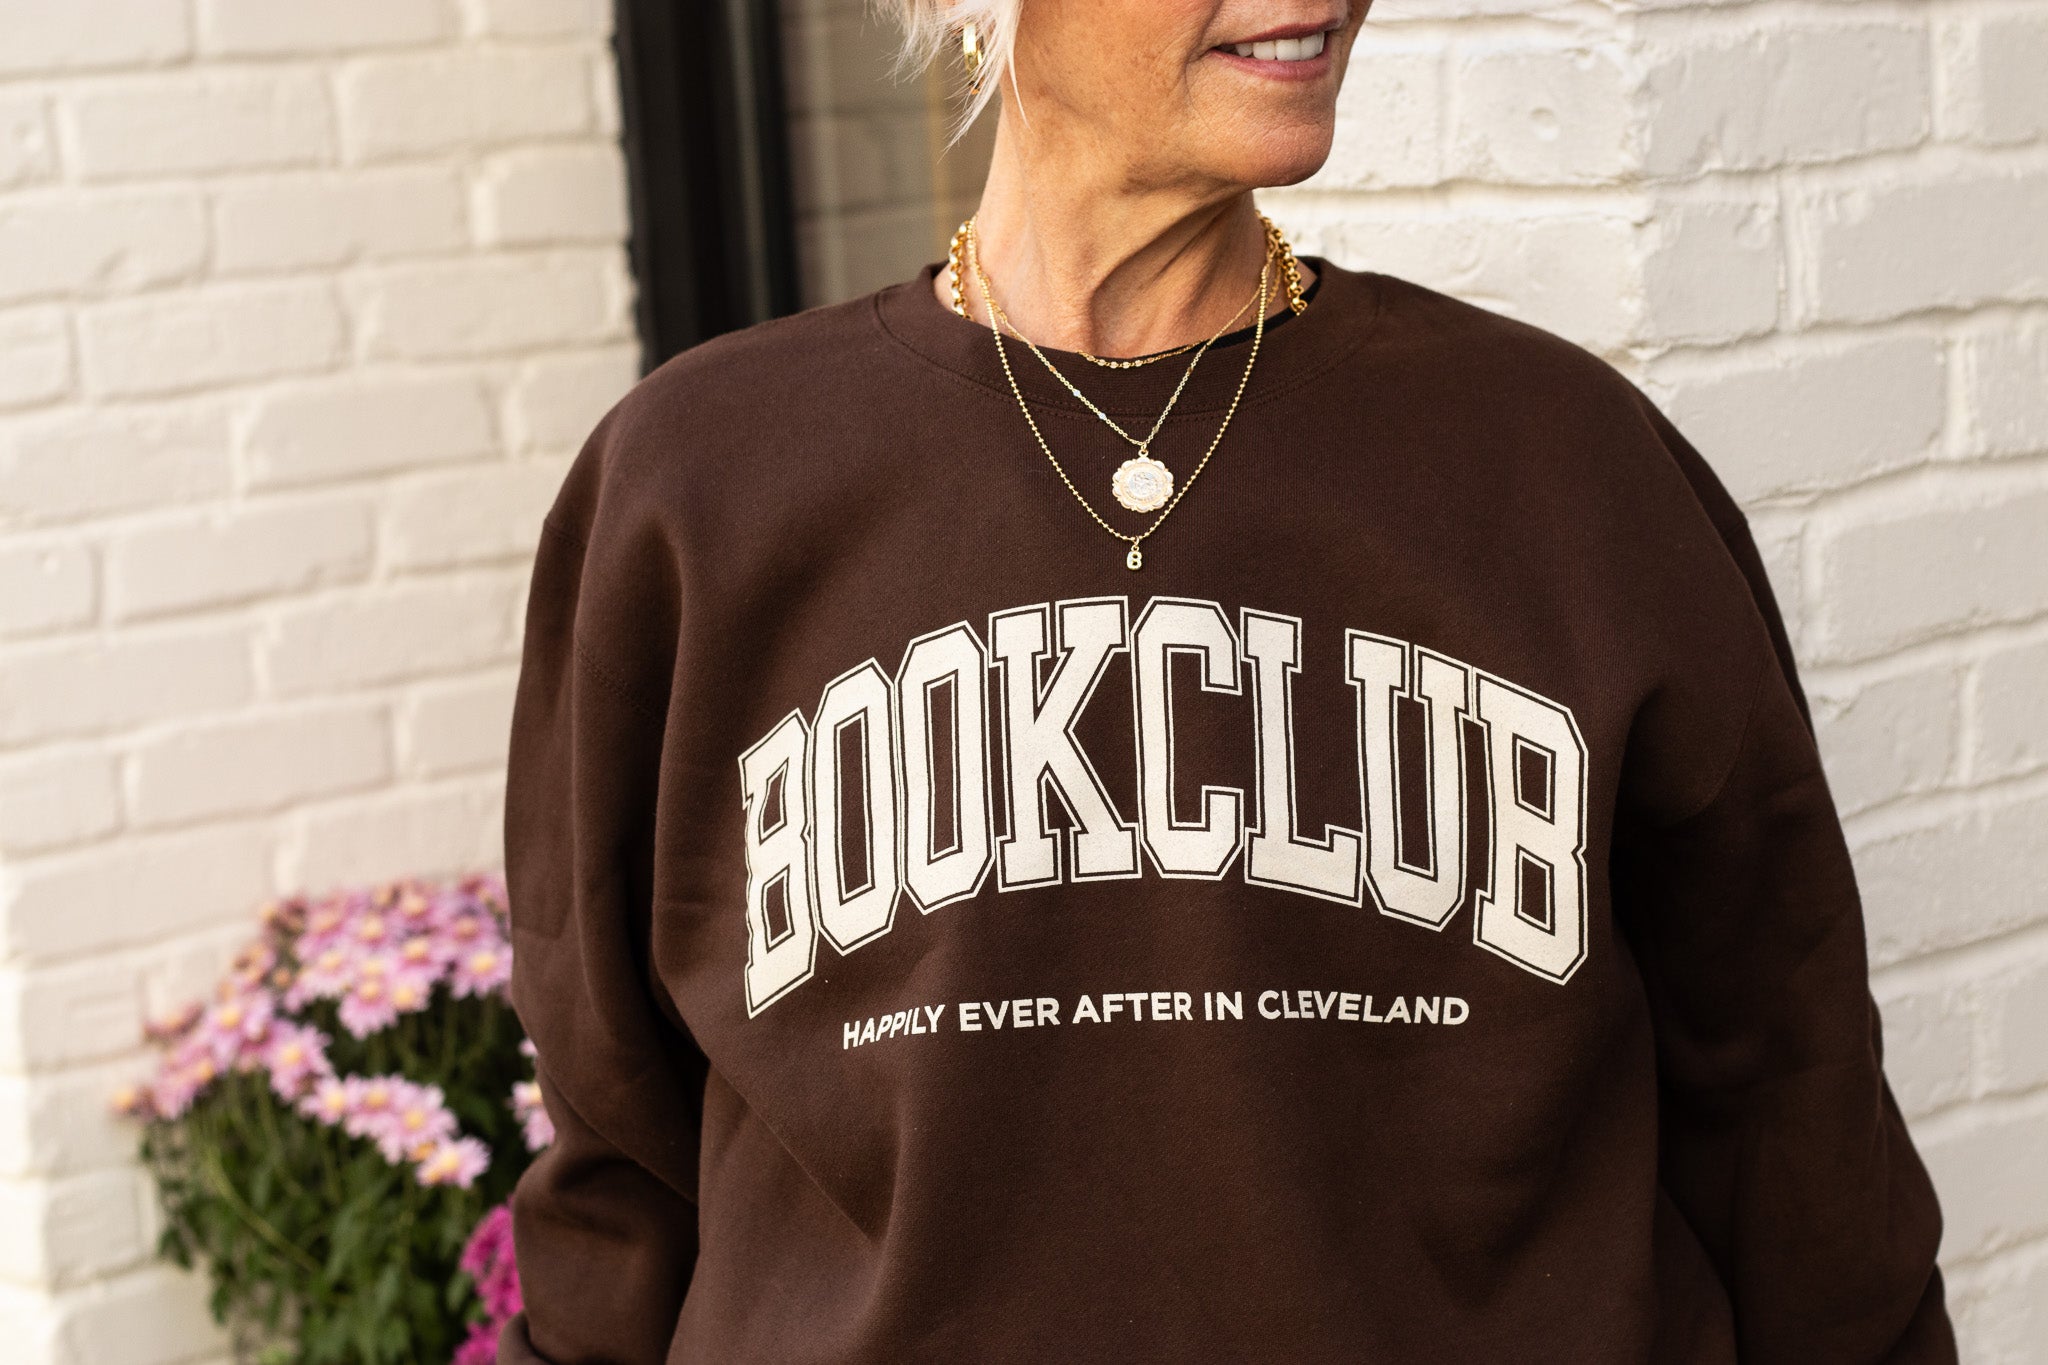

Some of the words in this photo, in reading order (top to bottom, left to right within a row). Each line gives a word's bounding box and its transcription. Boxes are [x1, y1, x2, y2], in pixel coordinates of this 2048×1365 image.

[737, 594, 1590, 1020] BOOKCLUB
[842, 1002, 946, 1051] HAPPILY
[958, 997, 1061, 1032] EVER
[1072, 991, 1194, 1024] AFTER
[1203, 991, 1244, 1021] IN
[1257, 989, 1470, 1026] CLEVELAND
